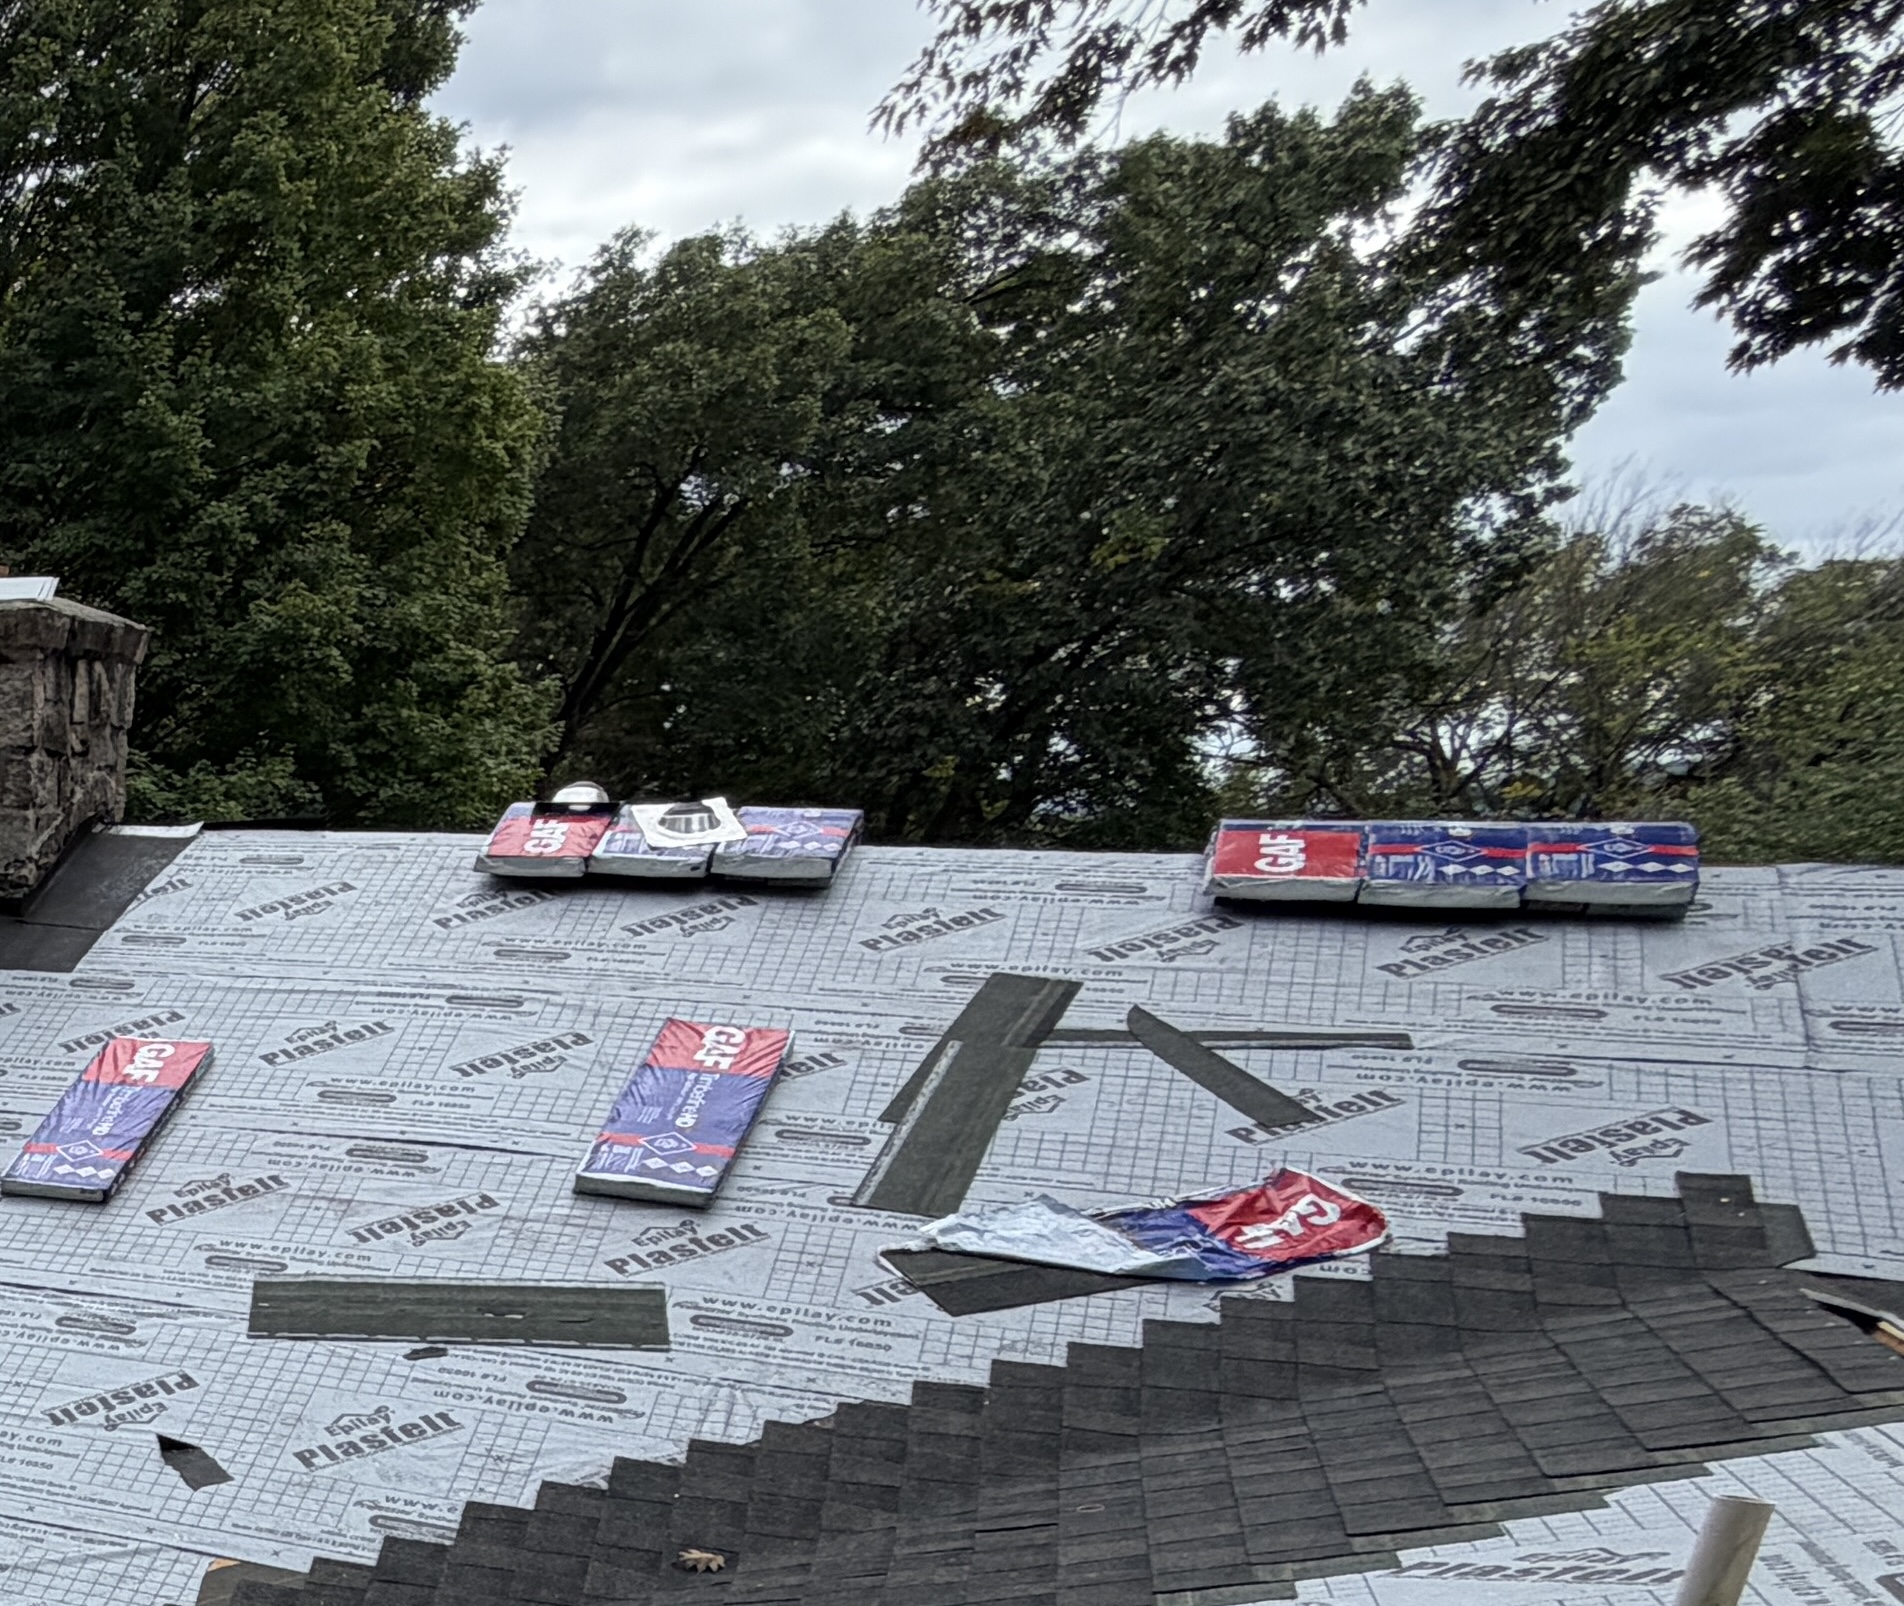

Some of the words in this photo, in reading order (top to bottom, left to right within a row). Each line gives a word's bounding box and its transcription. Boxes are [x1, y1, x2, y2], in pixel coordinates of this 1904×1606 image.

[524, 818, 570, 854] GAF
[1255, 833, 1305, 872] GAF
[121, 1043, 176, 1082] GAF
[694, 1026, 748, 1070] GAF
